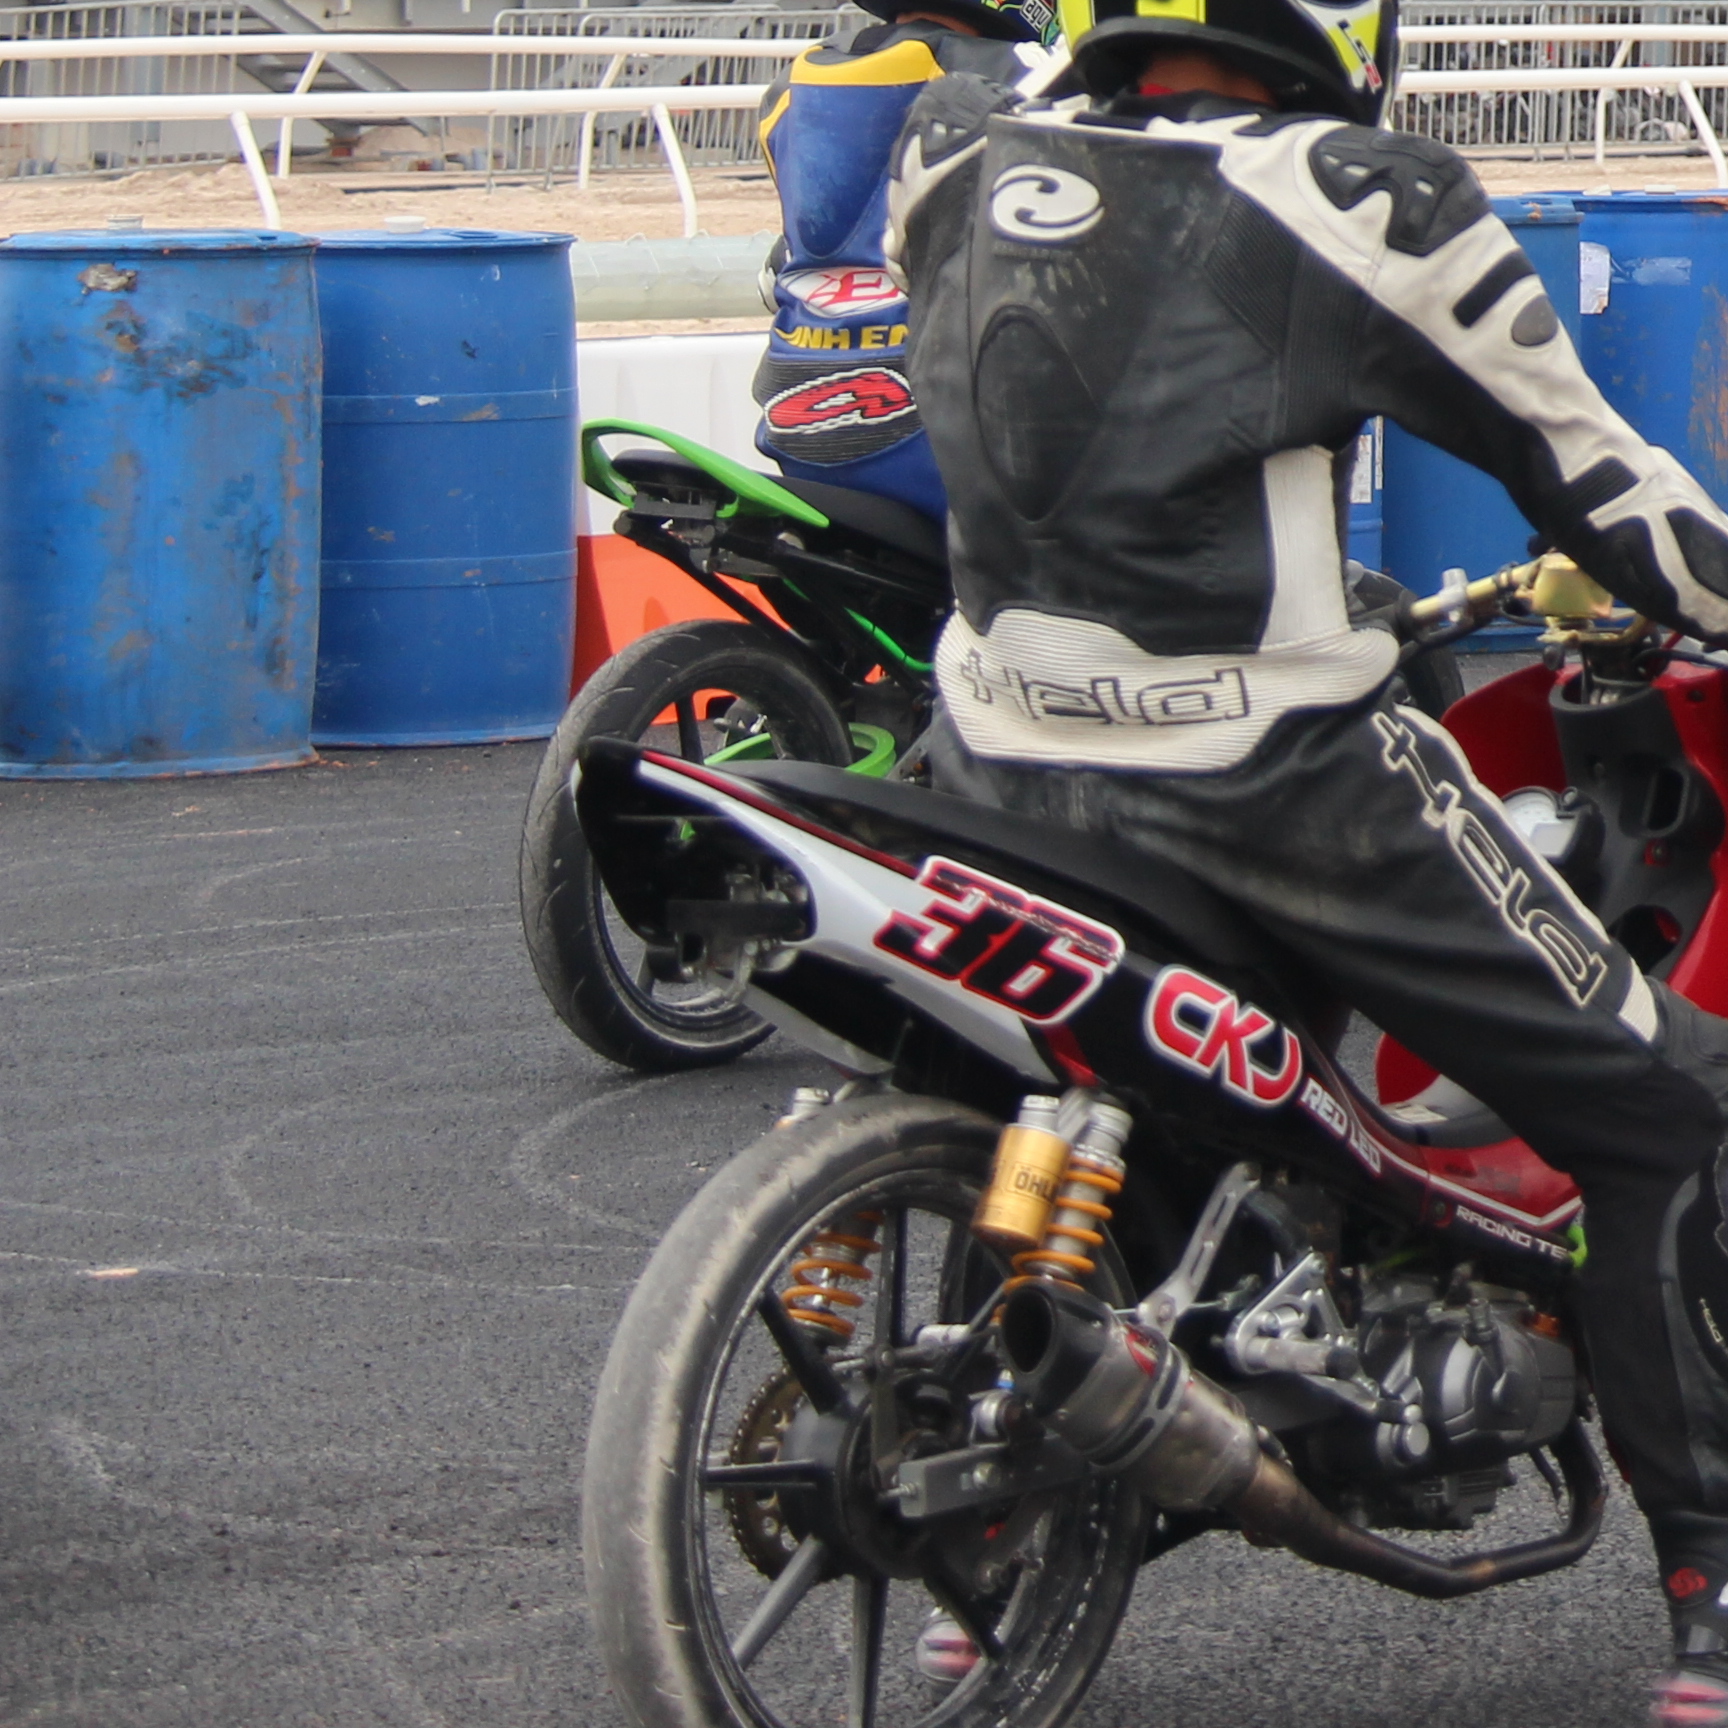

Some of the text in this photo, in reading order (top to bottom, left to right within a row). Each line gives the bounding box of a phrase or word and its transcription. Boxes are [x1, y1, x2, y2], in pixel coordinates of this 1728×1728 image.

[958, 647, 1250, 725] Held
[1371, 710, 1608, 1009] Held
[872, 854, 1125, 1026] 36
[1299, 1076, 1348, 1138] RED
[1455, 1204, 1531, 1250] RACING
